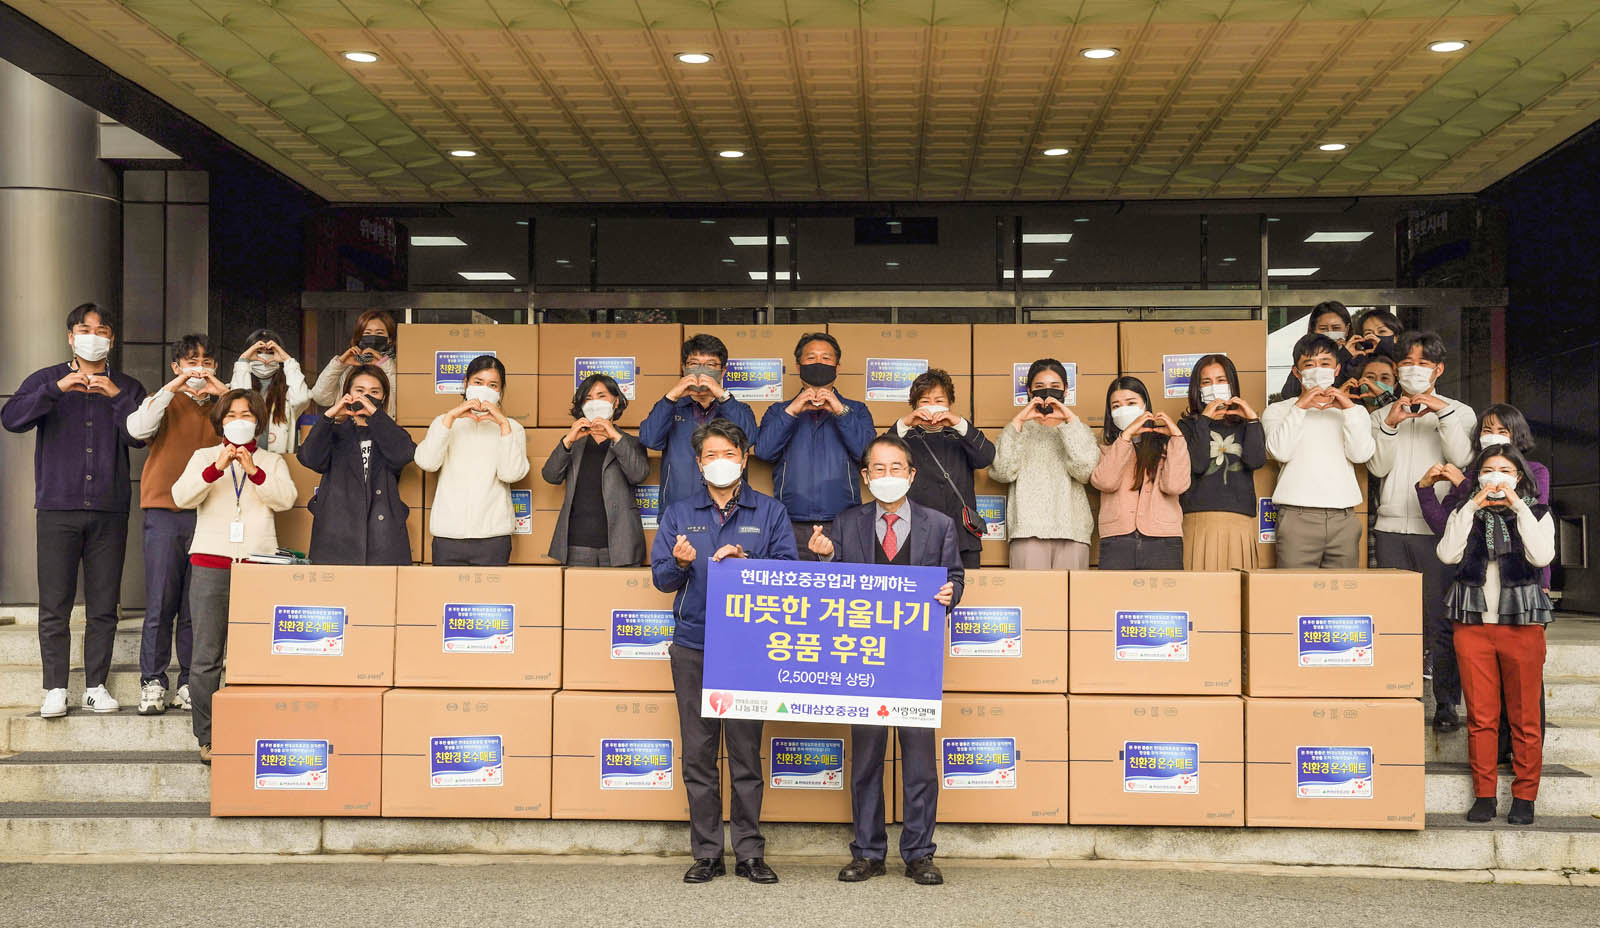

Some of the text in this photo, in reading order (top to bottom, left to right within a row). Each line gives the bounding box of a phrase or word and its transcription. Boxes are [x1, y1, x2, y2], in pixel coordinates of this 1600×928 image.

[440, 364, 462, 374] 친환경
[726, 371, 778, 381] 친환경 온수매트
[871, 371, 892, 381] 친환경
[741, 569, 918, 593] 현대삼호중공업과 함께하는
[725, 594, 930, 631] 따뜻한 겨울나기
[278, 620, 340, 633] 친환경 온수매트
[448, 618, 510, 630] 친환경 온수매트
[616, 624, 642, 636] 친환경
[955, 622, 1017, 634] 친환경 온수매트
[1121, 626, 1184, 638] 친환경 온수매트
[1304, 631, 1368, 643] 친환경 온수매트
[766, 632, 886, 666] 용품 후원
[778, 669, 875, 688] (2,500만원 상당)
[790, 703, 869, 718] 현대삼호중공업
[892, 706, 936, 716] 사랑의열매
[260, 754, 323, 766] 친환경 온수매트
[435, 751, 497, 764] 친환경 온수매트
[606, 754, 668, 766] 친환경 온수매트
[776, 753, 838, 766] 친환경 온수매트
[948, 753, 1010, 765] 친환경 온수매트
[1129, 757, 1193, 770] 친환경 온수매트
[1302, 762, 1367, 774] 친환경 온수매트
